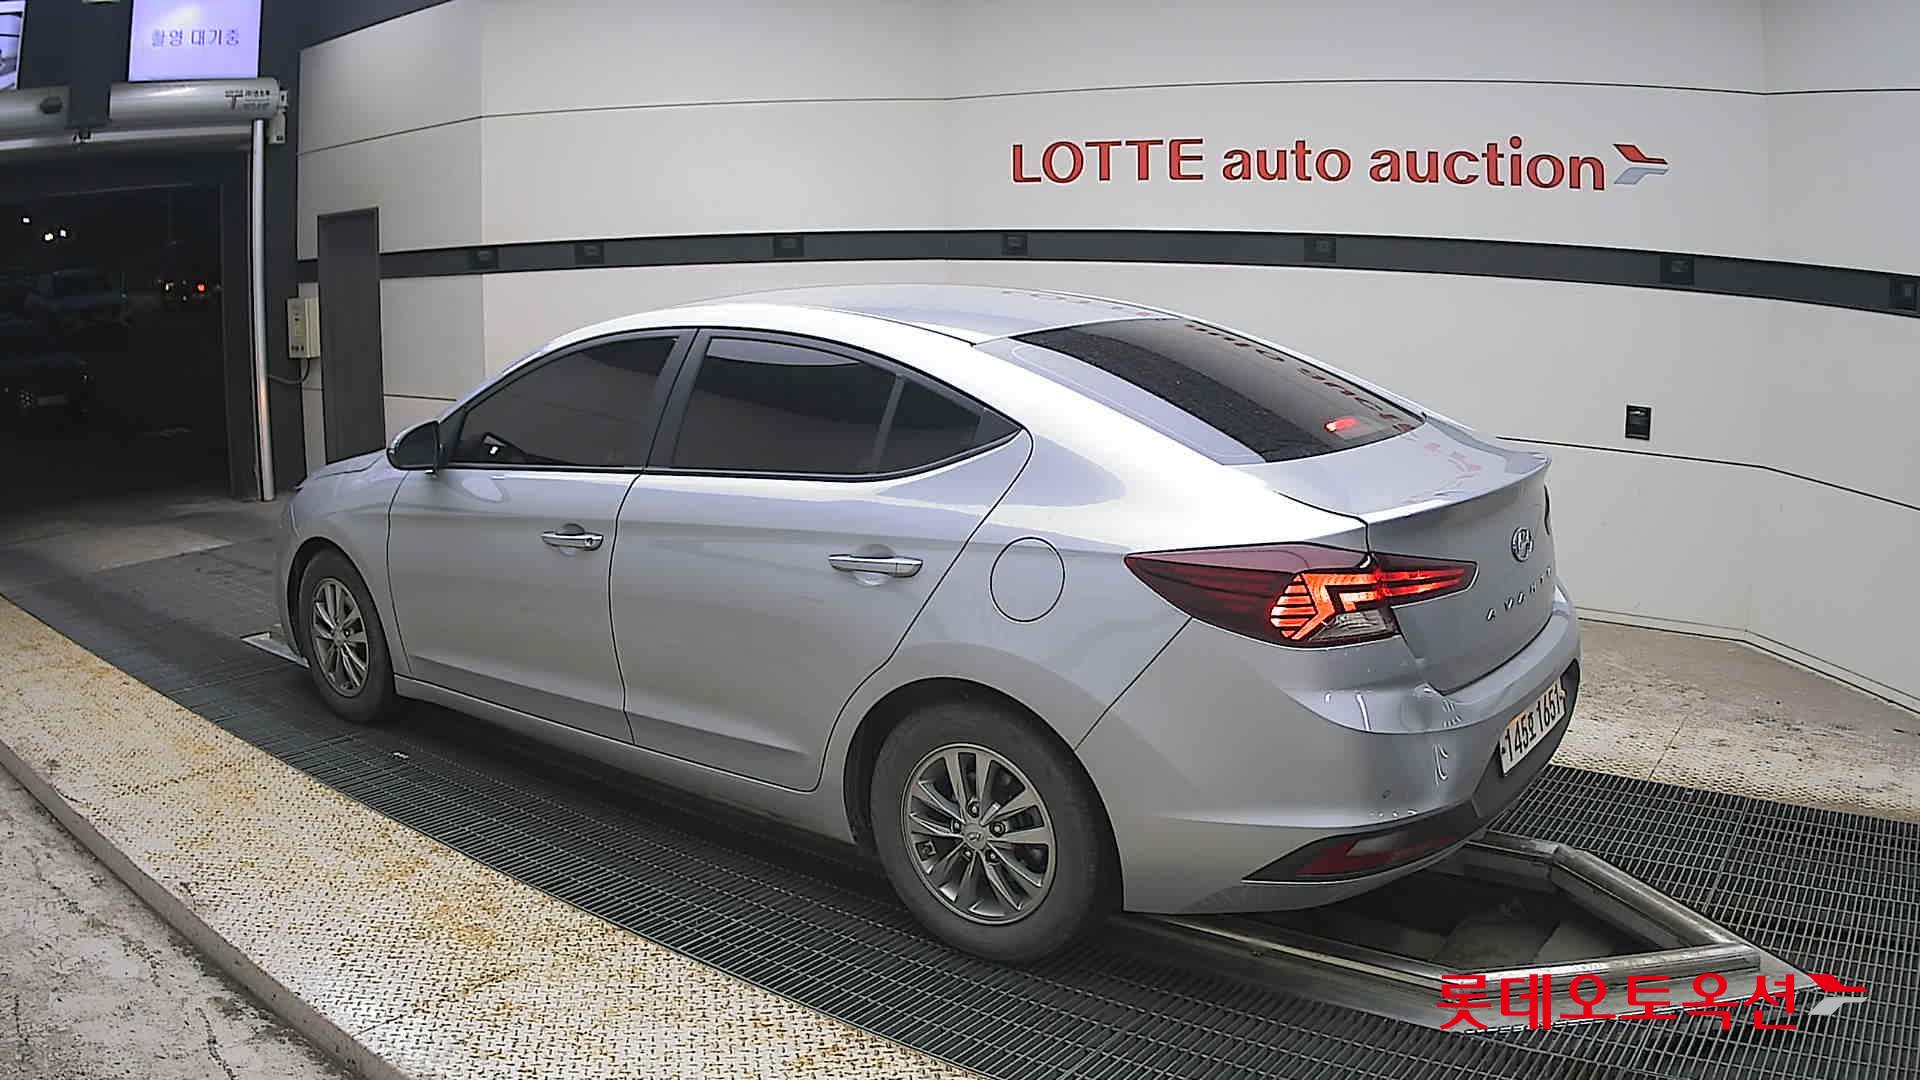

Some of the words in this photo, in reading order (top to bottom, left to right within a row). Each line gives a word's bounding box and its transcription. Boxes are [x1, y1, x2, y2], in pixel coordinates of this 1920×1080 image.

[191, 29, 239, 48] 대기중
[1012, 138, 1204, 183] LOTTE
[1222, 139, 1352, 182] auto
[1369, 136, 1606, 190] auction
